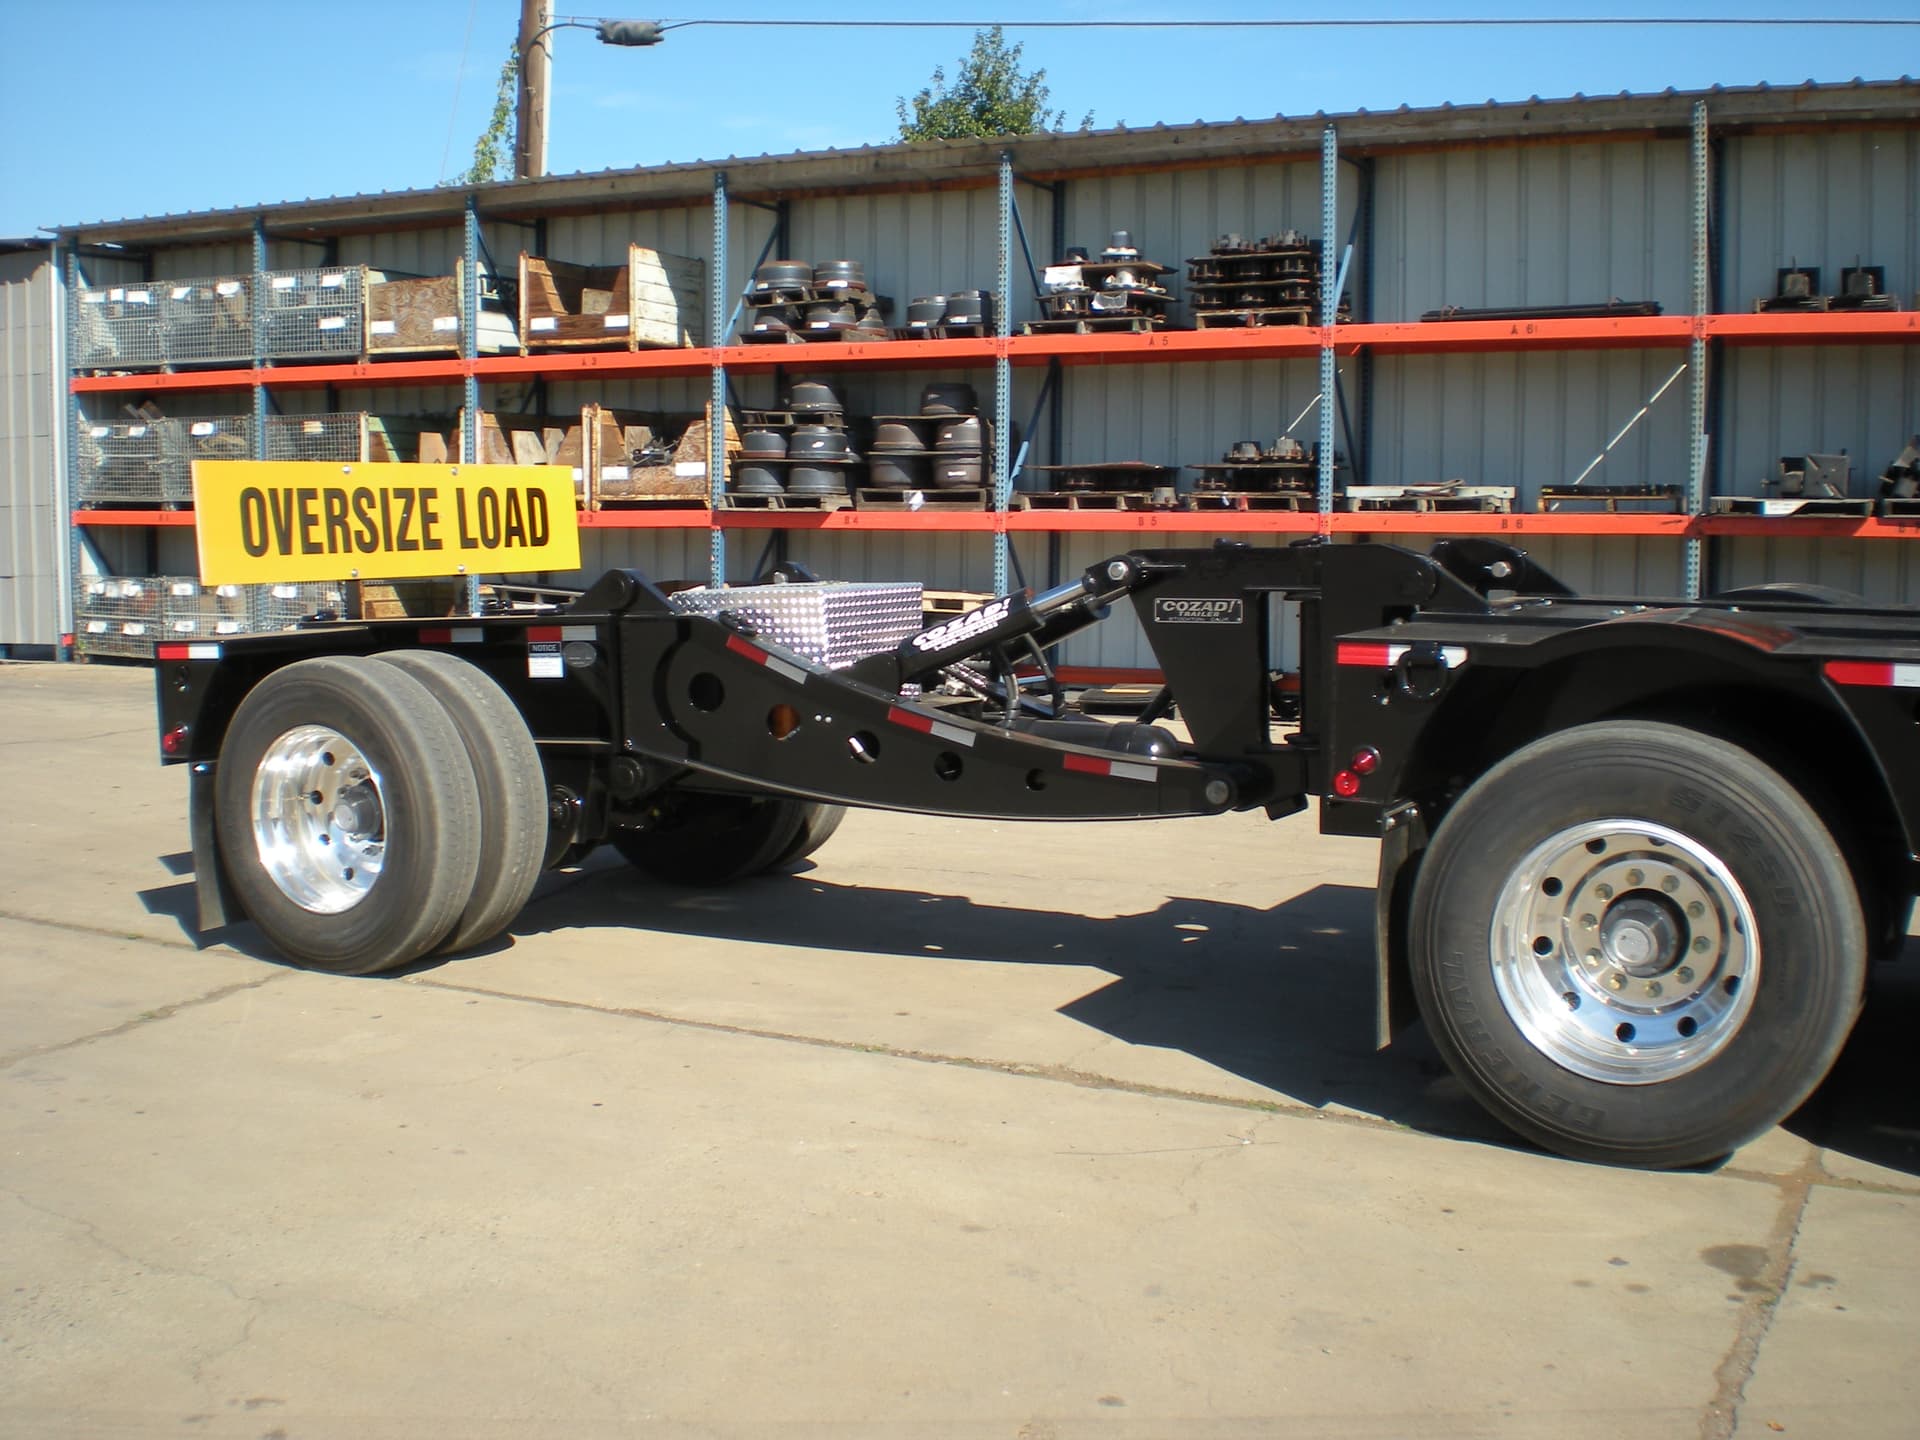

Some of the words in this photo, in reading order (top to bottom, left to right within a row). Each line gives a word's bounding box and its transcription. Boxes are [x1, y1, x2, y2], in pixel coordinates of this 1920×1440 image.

[239, 486, 444, 557] OVERSIZE
[455, 486, 550, 549] LOAD
[911, 597, 1011, 647] COZAD!
[1162, 600, 1235, 613] COZAD!
[532, 644, 557, 652] NOTICE
